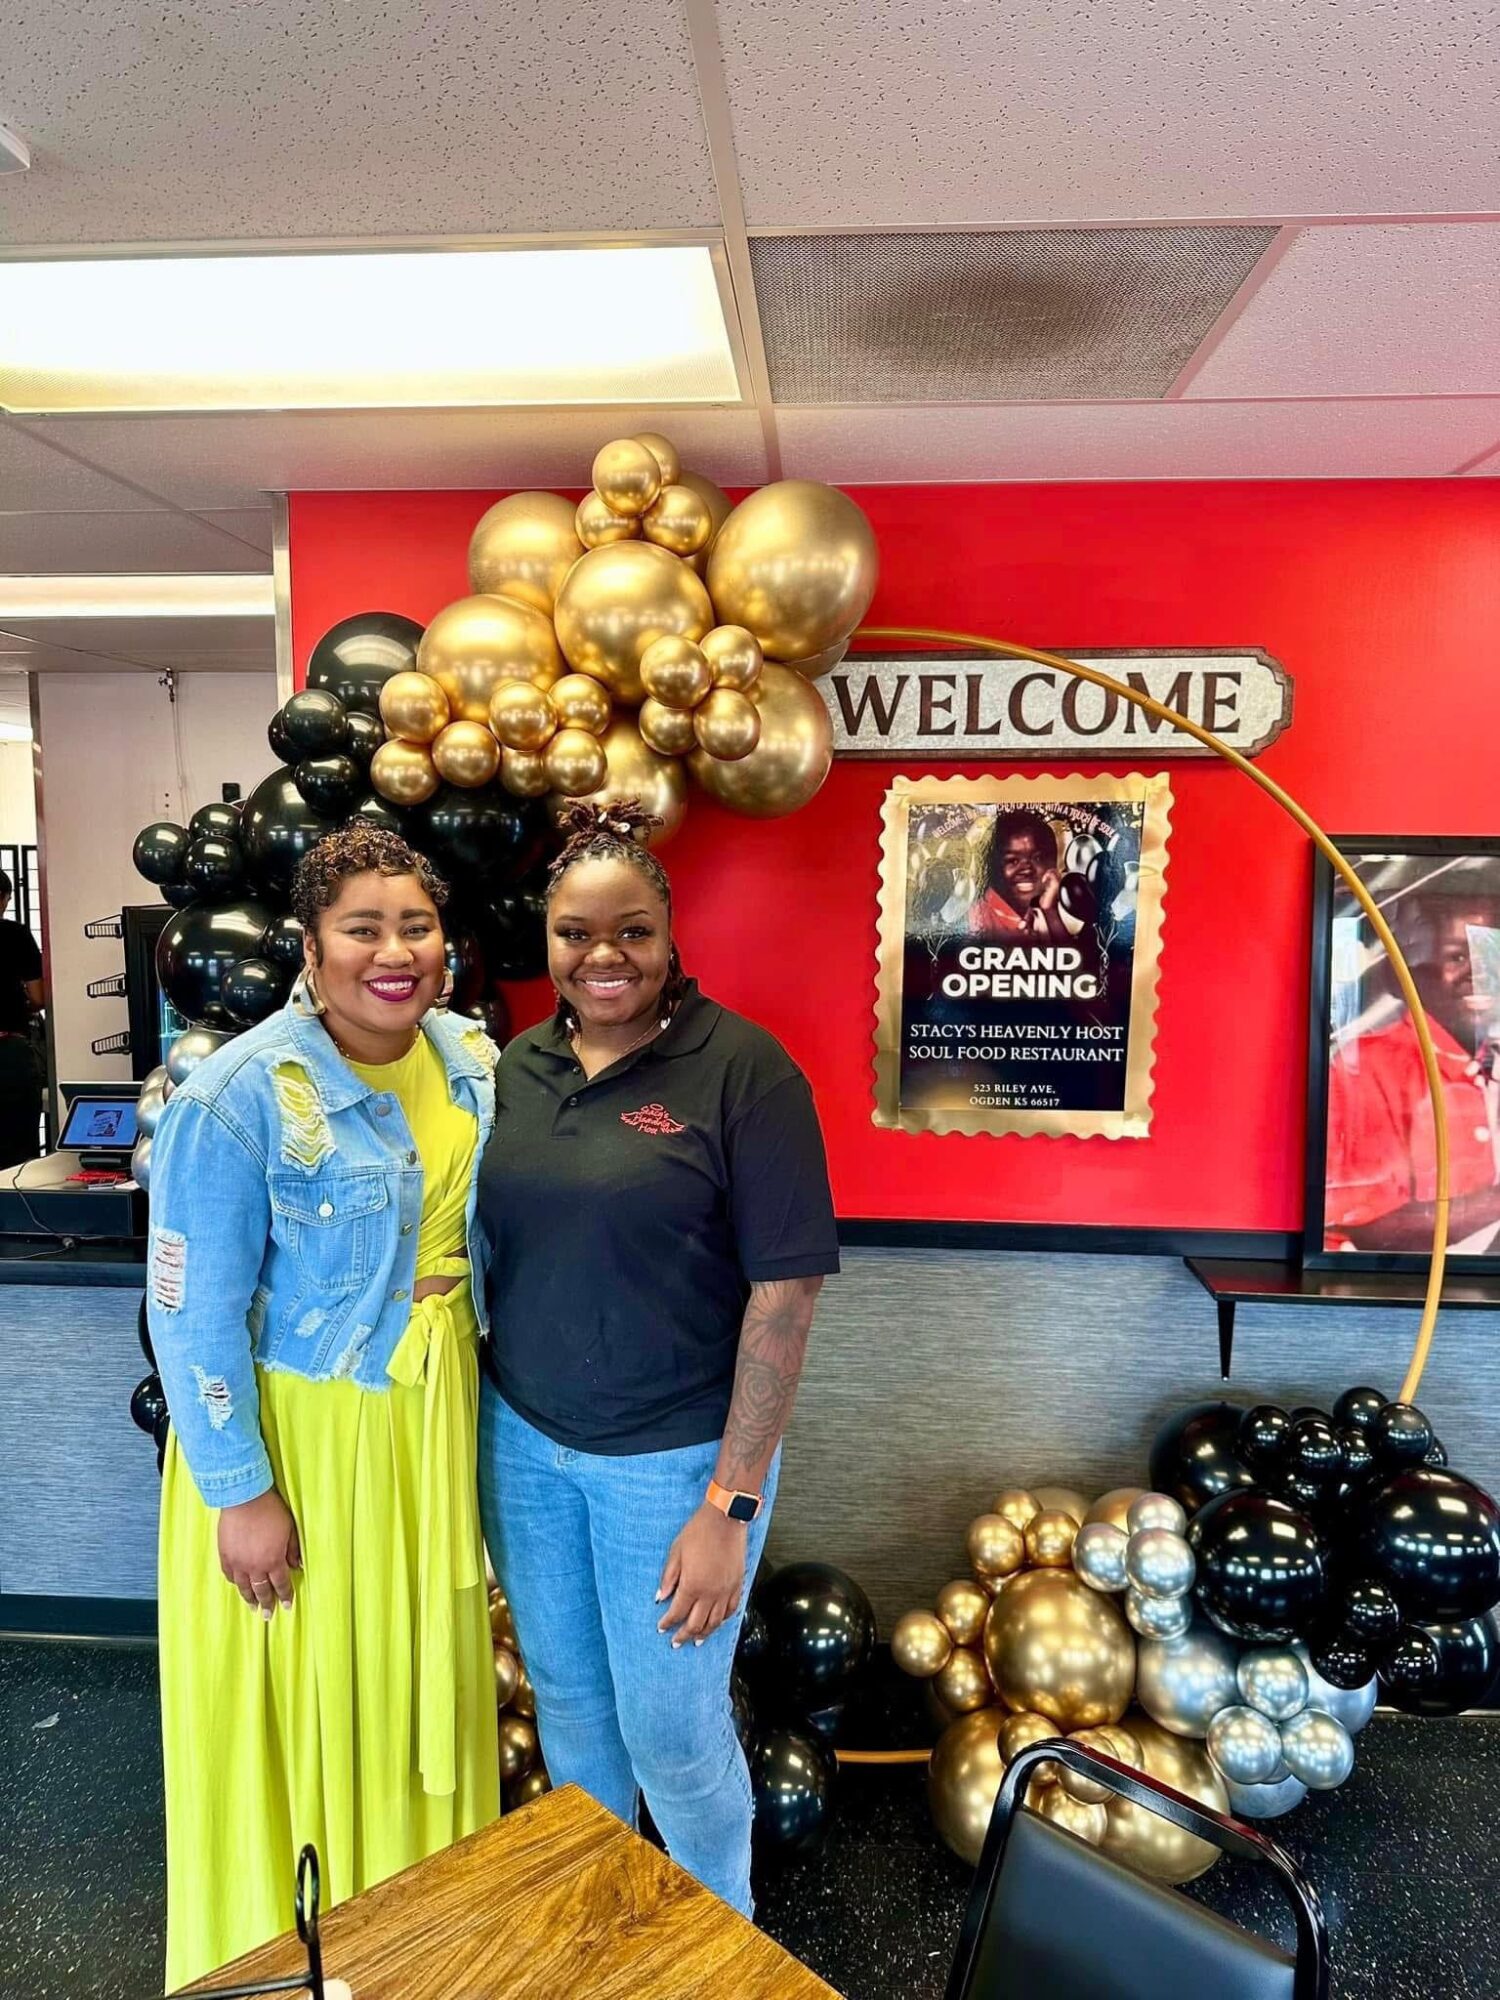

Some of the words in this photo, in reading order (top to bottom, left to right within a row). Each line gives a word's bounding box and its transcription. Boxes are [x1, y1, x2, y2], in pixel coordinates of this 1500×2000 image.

[832, 672, 1242, 736] WELCOME
[958, 946, 1082, 971] GRAND
[942, 973, 1097, 999] OPENING
[910, 1024, 976, 1038] STACY'S
[980, 1025, 1071, 1039] HEAVENLY
[1075, 1026, 1124, 1040] HOST
[909, 1045, 953, 1059] SOUL
[957, 1046, 1006, 1060] FOOD
[1010, 1047, 1124, 1062] RESTAURANT
[973, 1084, 991, 1092] 523
[994, 1084, 1027, 1093] RILEY
[969, 1096, 1010, 1106] OGDEN
[1014, 1097, 1028, 1106] KS
[1030, 1098, 1060, 1107] 66517
